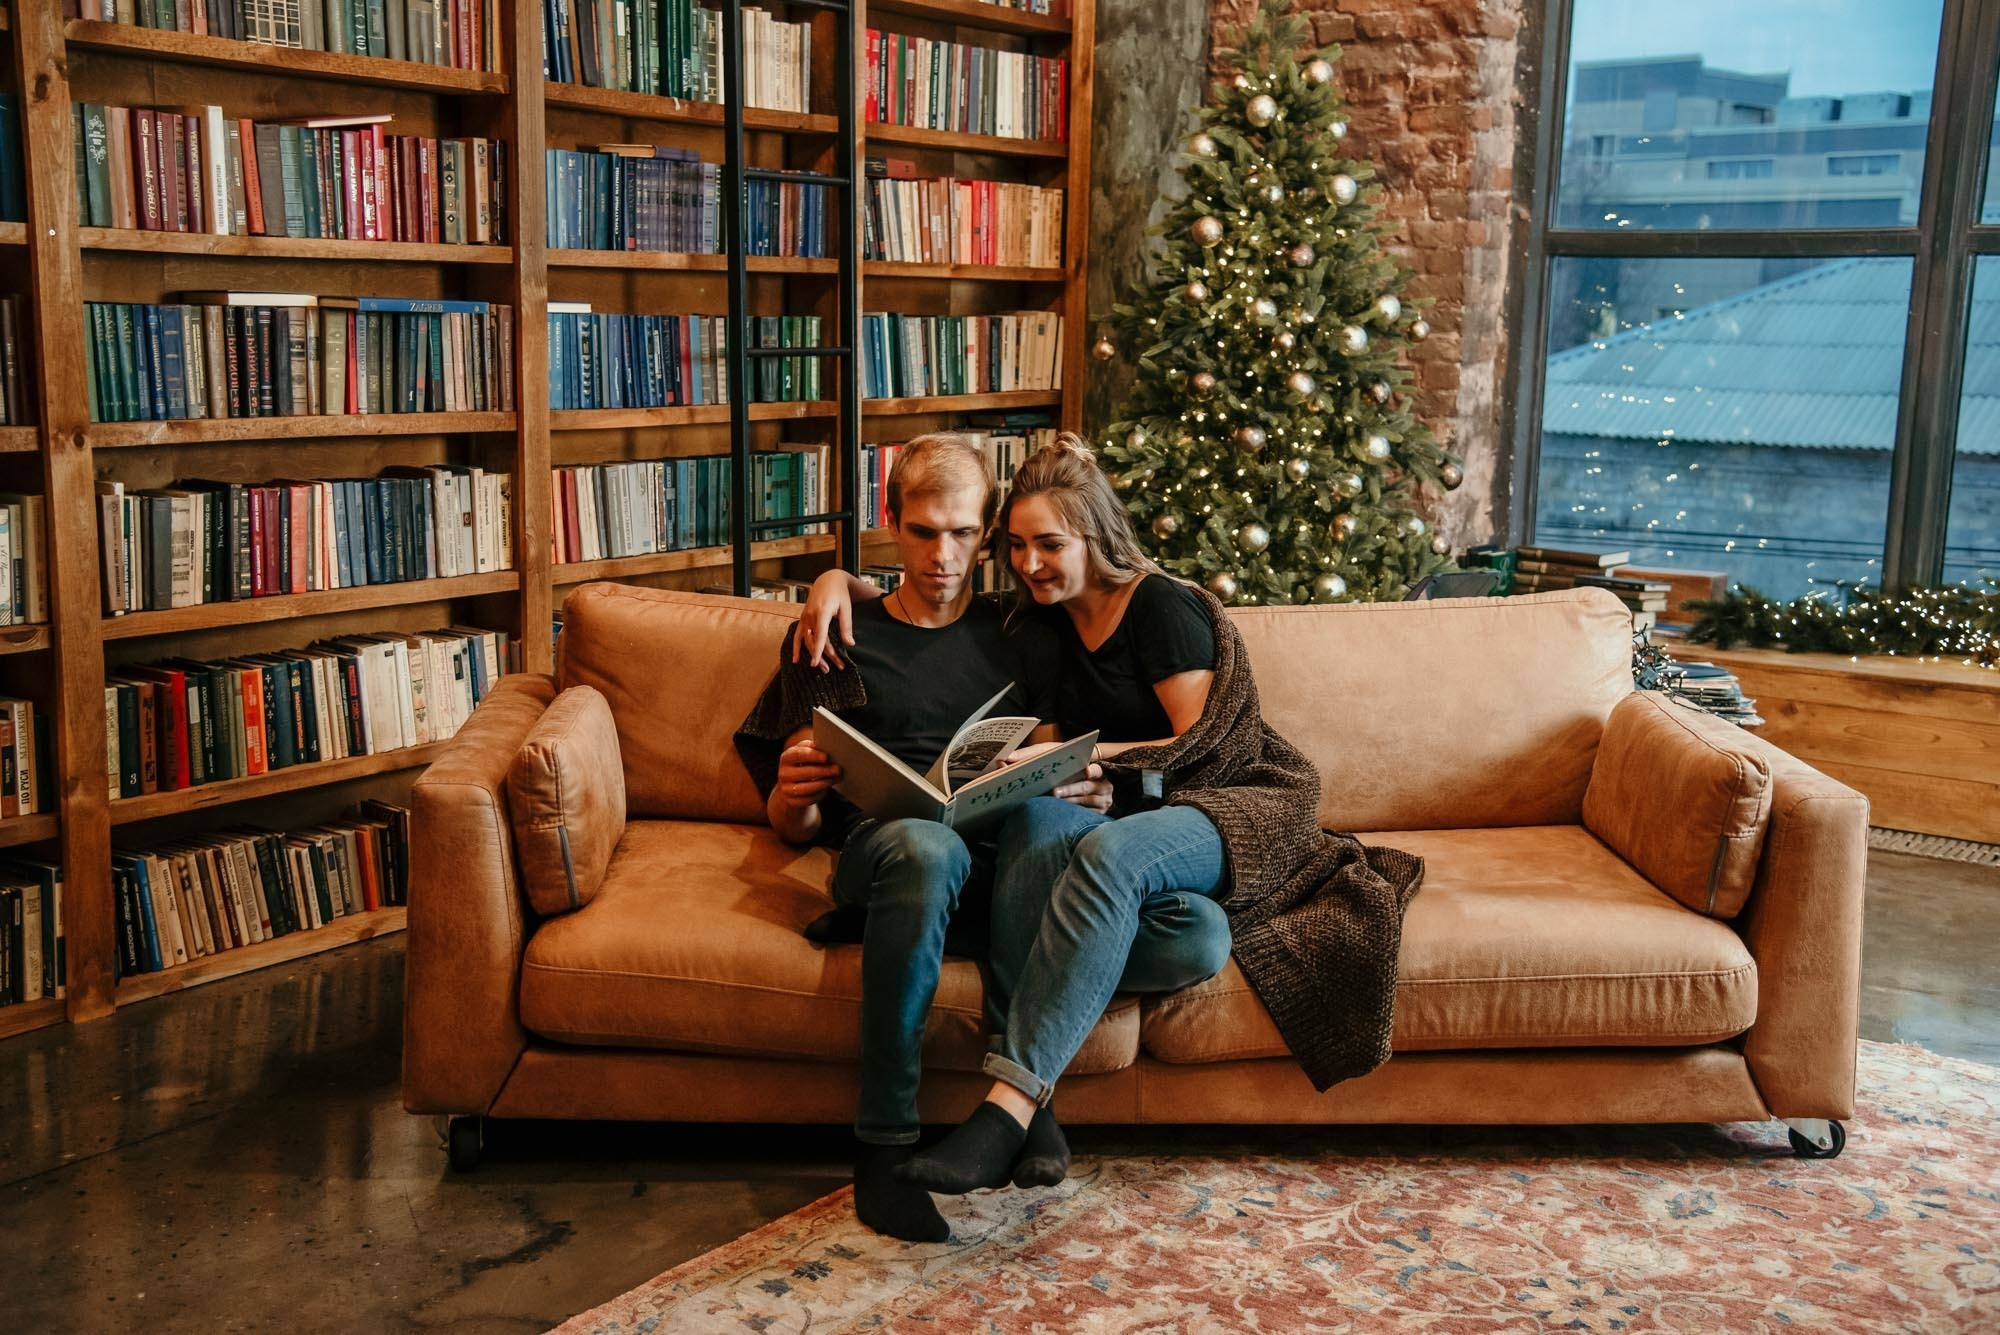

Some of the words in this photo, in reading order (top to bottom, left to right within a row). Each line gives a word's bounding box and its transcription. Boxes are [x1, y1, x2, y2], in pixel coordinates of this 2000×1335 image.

[409, 302, 444, 313] ZAGREB
[246, 336, 258, 389] ВОЙНИЧ
[20, 769, 29, 791] РУСИ
[21, 791, 30, 805] ПО
